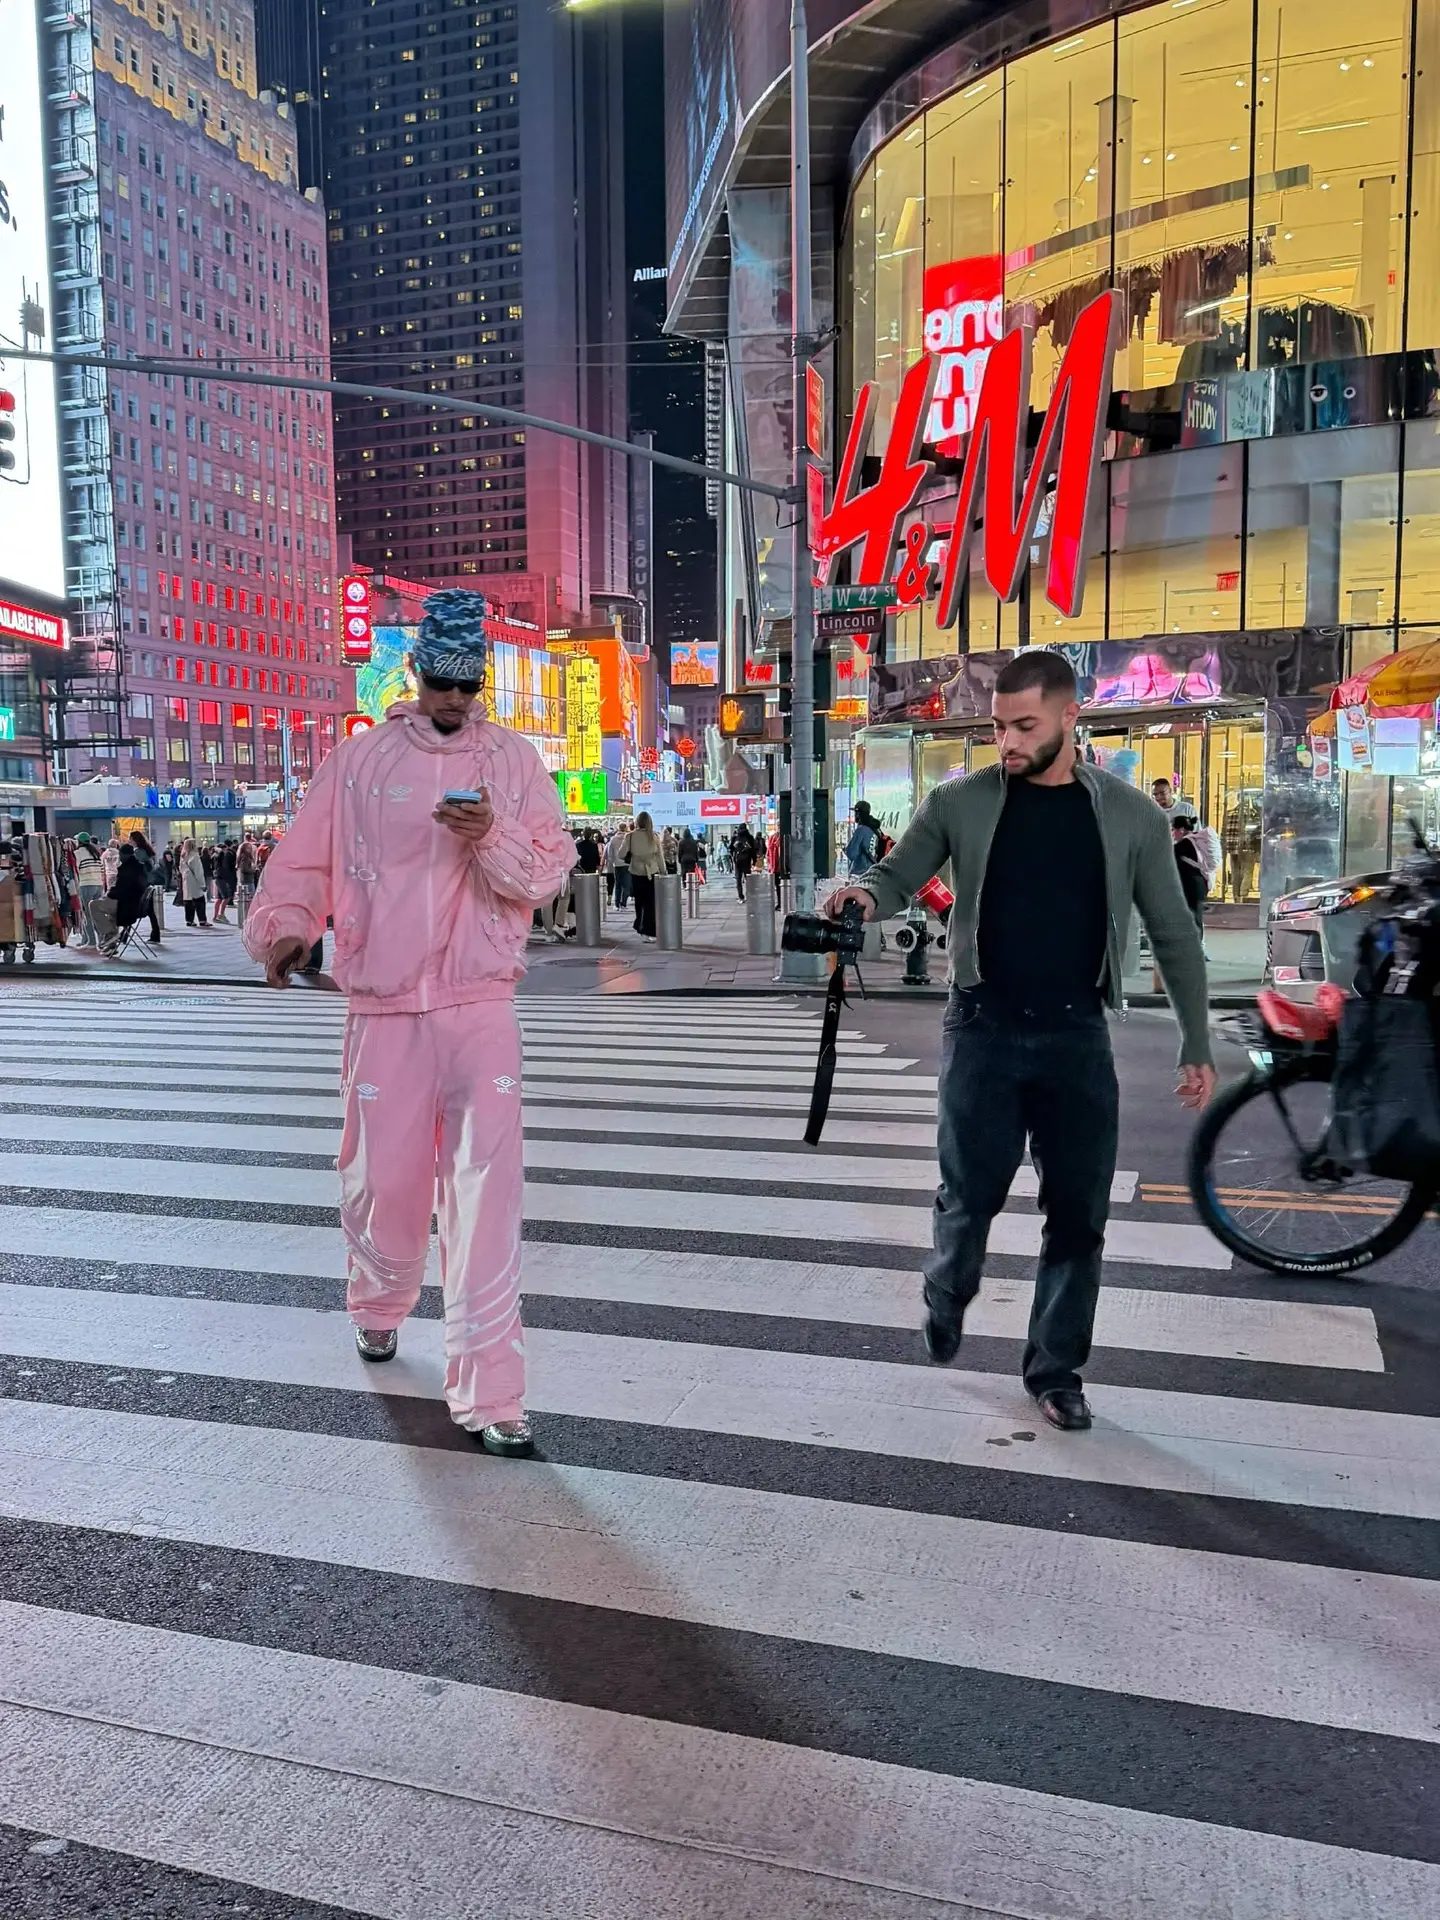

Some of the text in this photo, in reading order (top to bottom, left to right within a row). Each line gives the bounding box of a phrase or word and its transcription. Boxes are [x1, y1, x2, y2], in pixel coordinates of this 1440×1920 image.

[822, 288, 1118, 652] H&M
[836, 585, 896, 606] W 42 St
[34, 616, 58, 641] NOW
[822, 613, 875, 630] Lincoln
